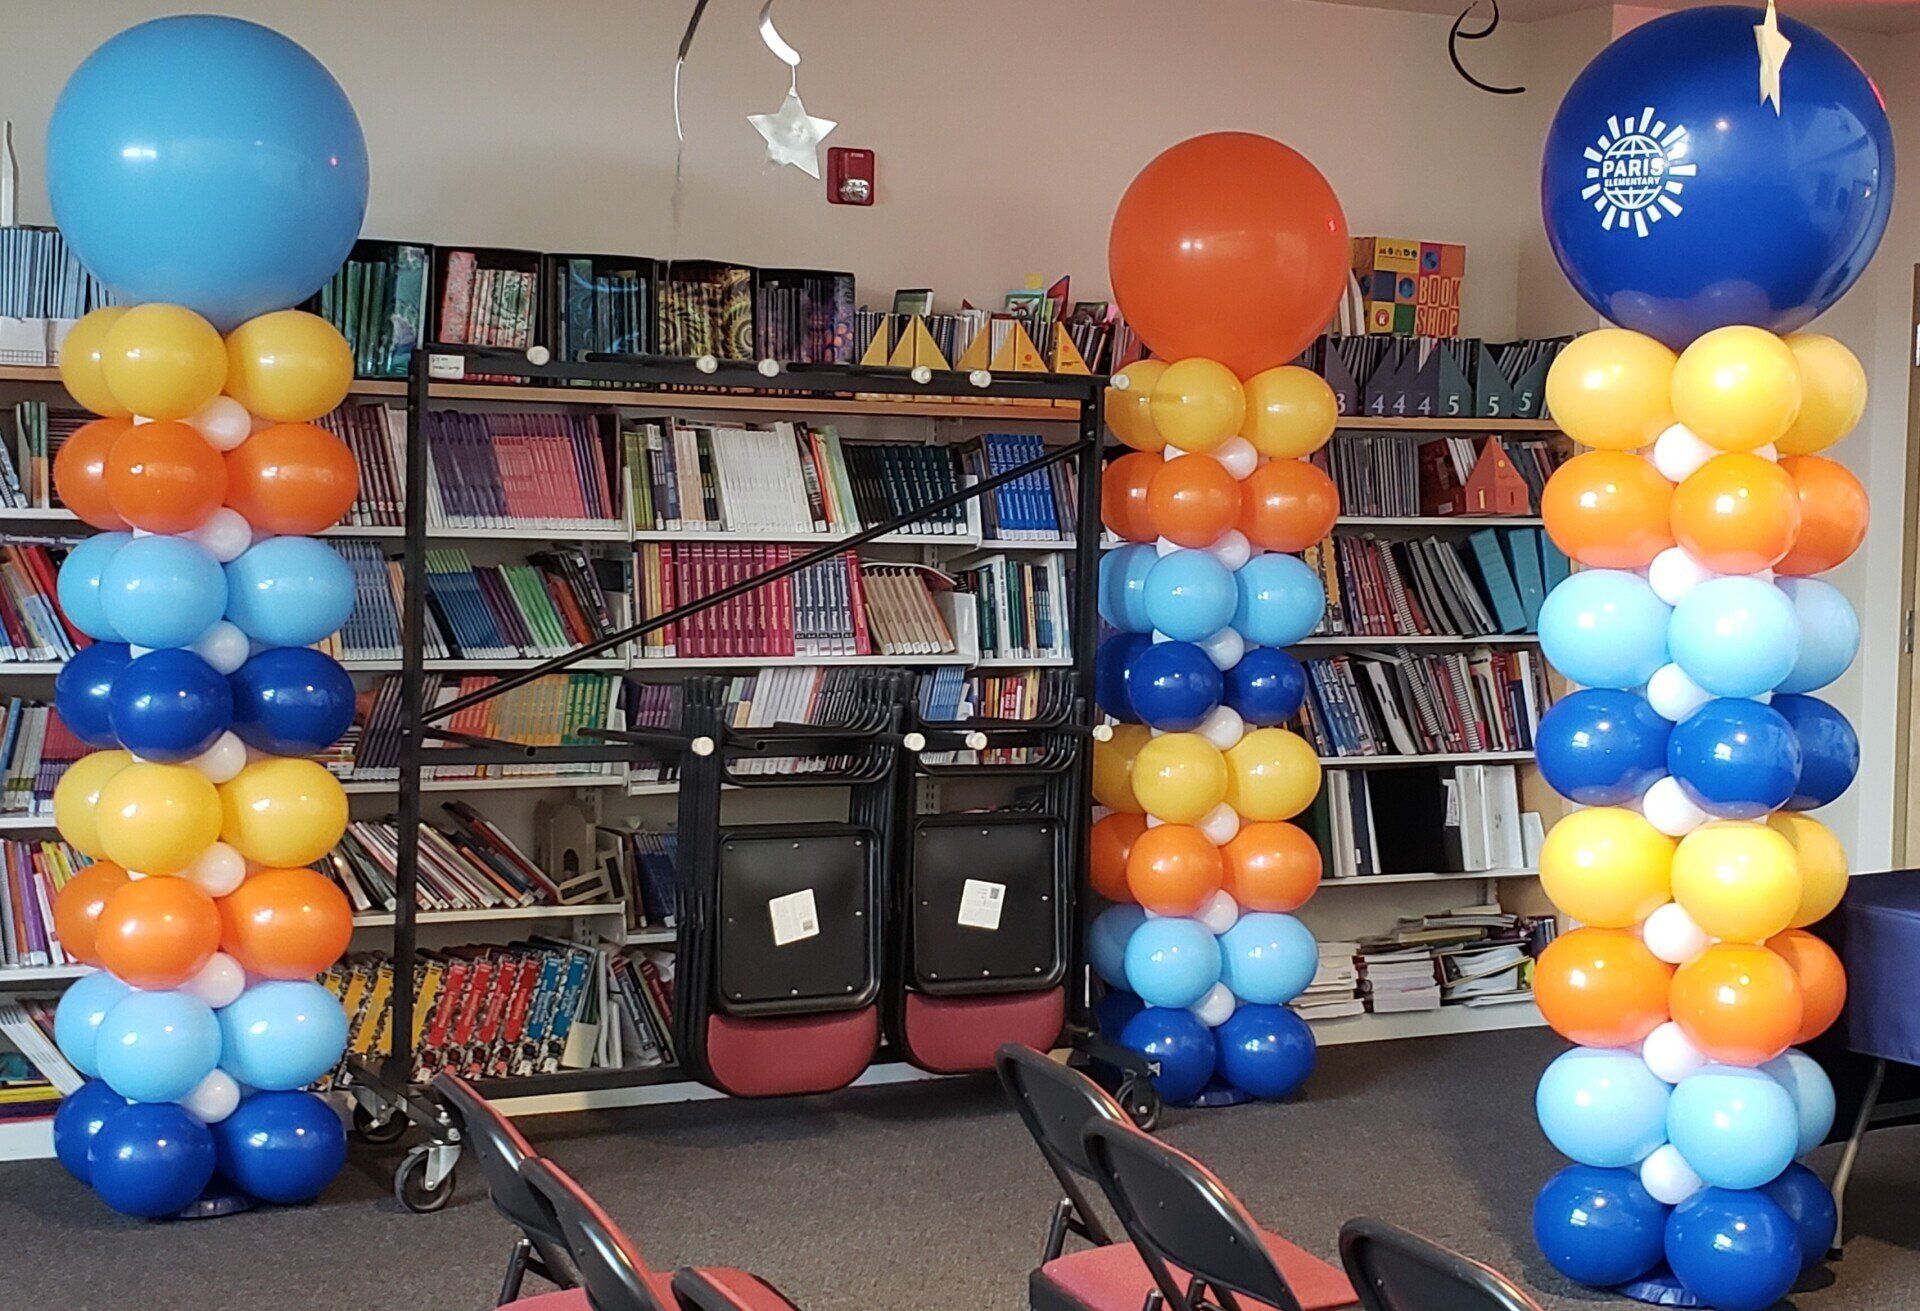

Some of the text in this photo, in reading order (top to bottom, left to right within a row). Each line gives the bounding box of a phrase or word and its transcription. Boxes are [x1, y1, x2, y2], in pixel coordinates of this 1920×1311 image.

[1602, 158, 1664, 178] PARIS
[1604, 177, 1660, 187] ELEMENTARY
[1419, 274, 1461, 307] BOOK
[1414, 305, 1459, 337] SHOP
[1371, 394, 1384, 414] 4
[1392, 394, 1406, 414] 4
[1418, 396, 1431, 415] 4
[1447, 395, 1460, 416] 5
[1487, 396, 1500, 416] 5
[1519, 392, 1532, 412] 5
